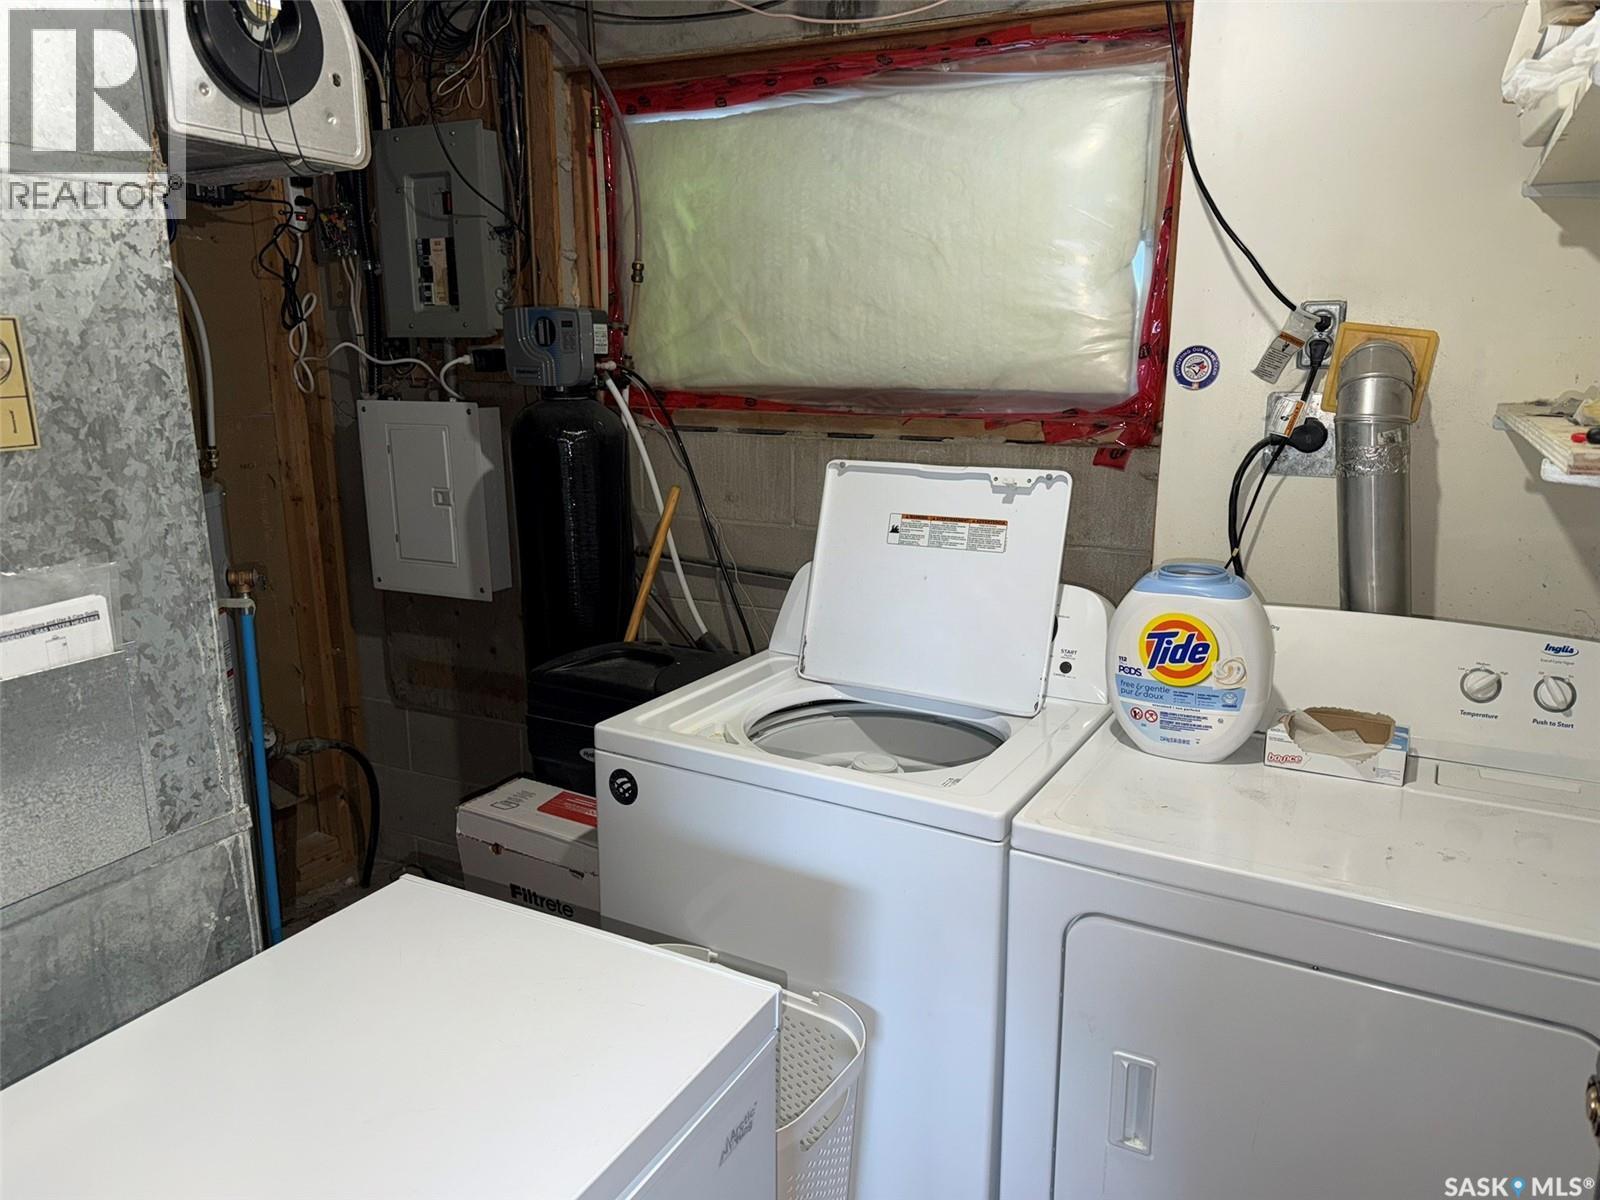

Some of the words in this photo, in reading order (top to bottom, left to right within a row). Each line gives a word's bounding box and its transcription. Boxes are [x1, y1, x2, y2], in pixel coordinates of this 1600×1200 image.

[1146, 630, 1211, 669] Tide
[1544, 643, 1575, 654] Inglis
[1118, 665, 1142, 678] PODS
[1120, 679, 1135, 689] free
[1144, 684, 1171, 695] gentle
[1120, 688, 1134, 697] pur
[1144, 690, 1164, 700] doux
[1460, 709, 1499, 720] Temperature
[1532, 718, 1548, 727] Push
[1557, 721, 1574, 729] Start
[1267, 752, 1303, 764] bounce
[509, 883, 574, 918] Filtrete
